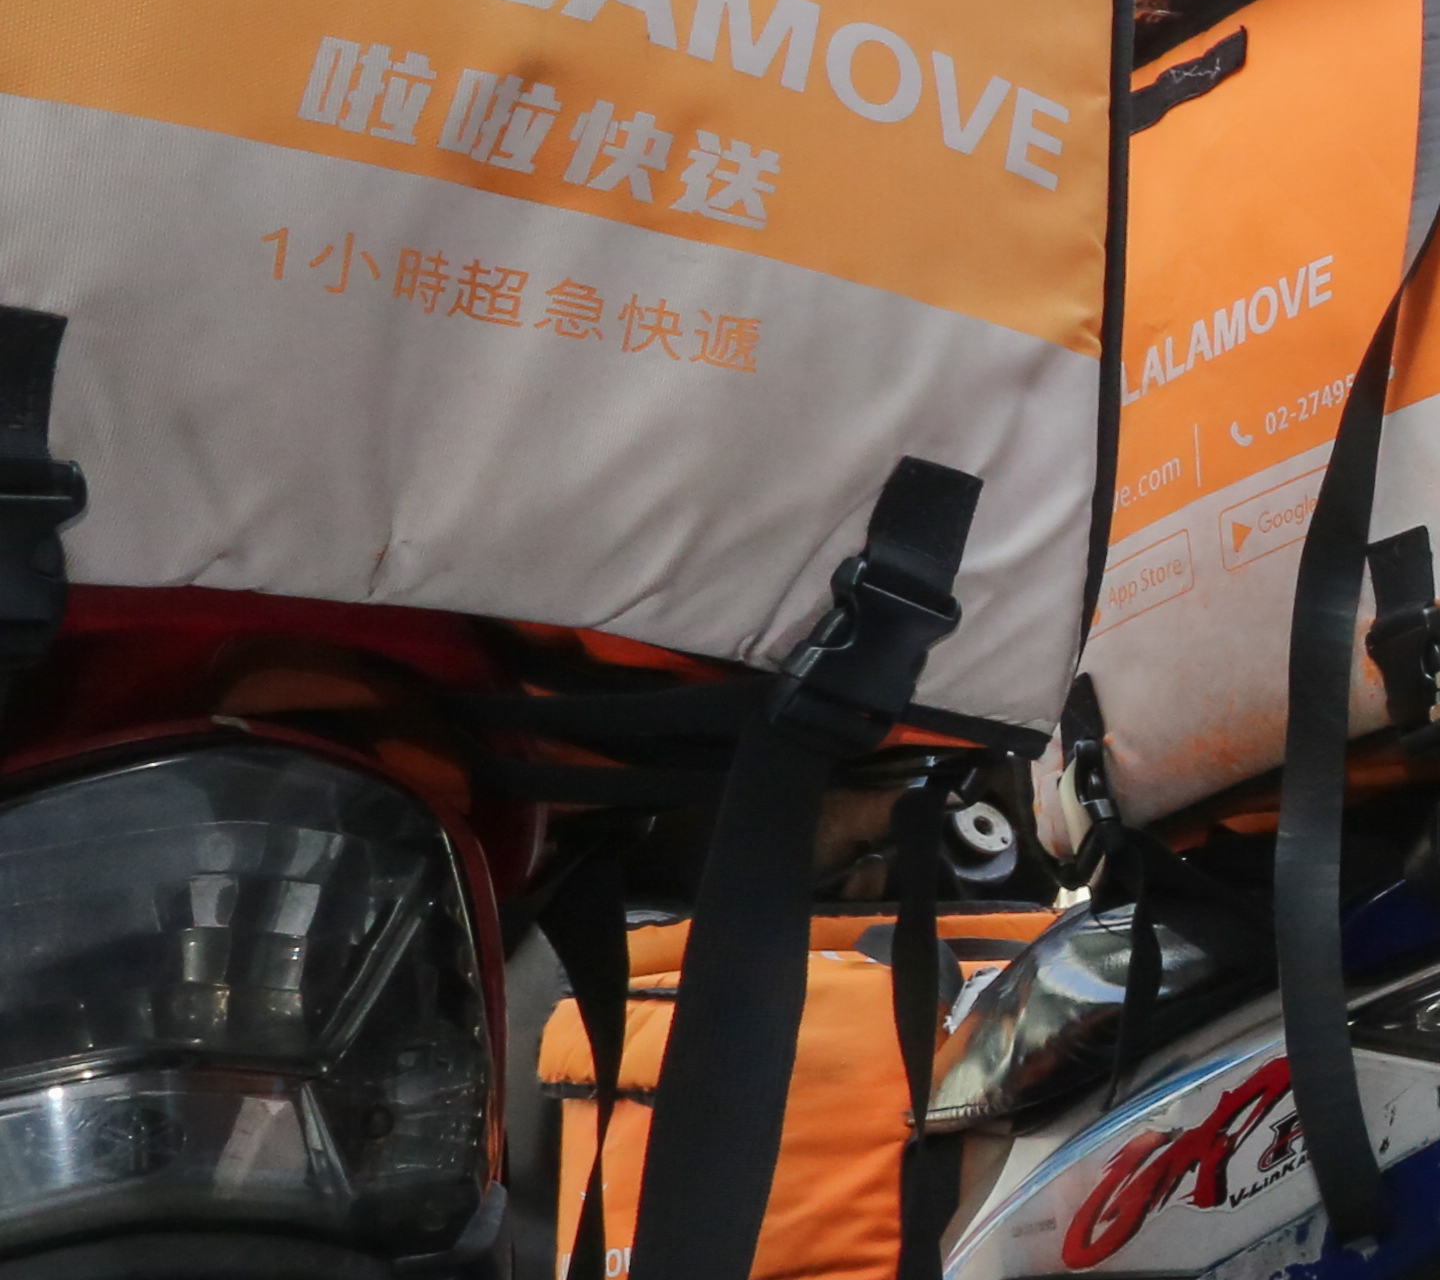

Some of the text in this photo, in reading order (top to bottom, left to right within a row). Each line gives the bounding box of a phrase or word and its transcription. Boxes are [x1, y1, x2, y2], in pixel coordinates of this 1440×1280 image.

[297, 36, 781, 231] 啦啦快送
[260, 226, 764, 375] 1小時超急快遞
[1120, 255, 1334, 407] LALAMOVE
[1107, 558, 1183, 609] App Store
